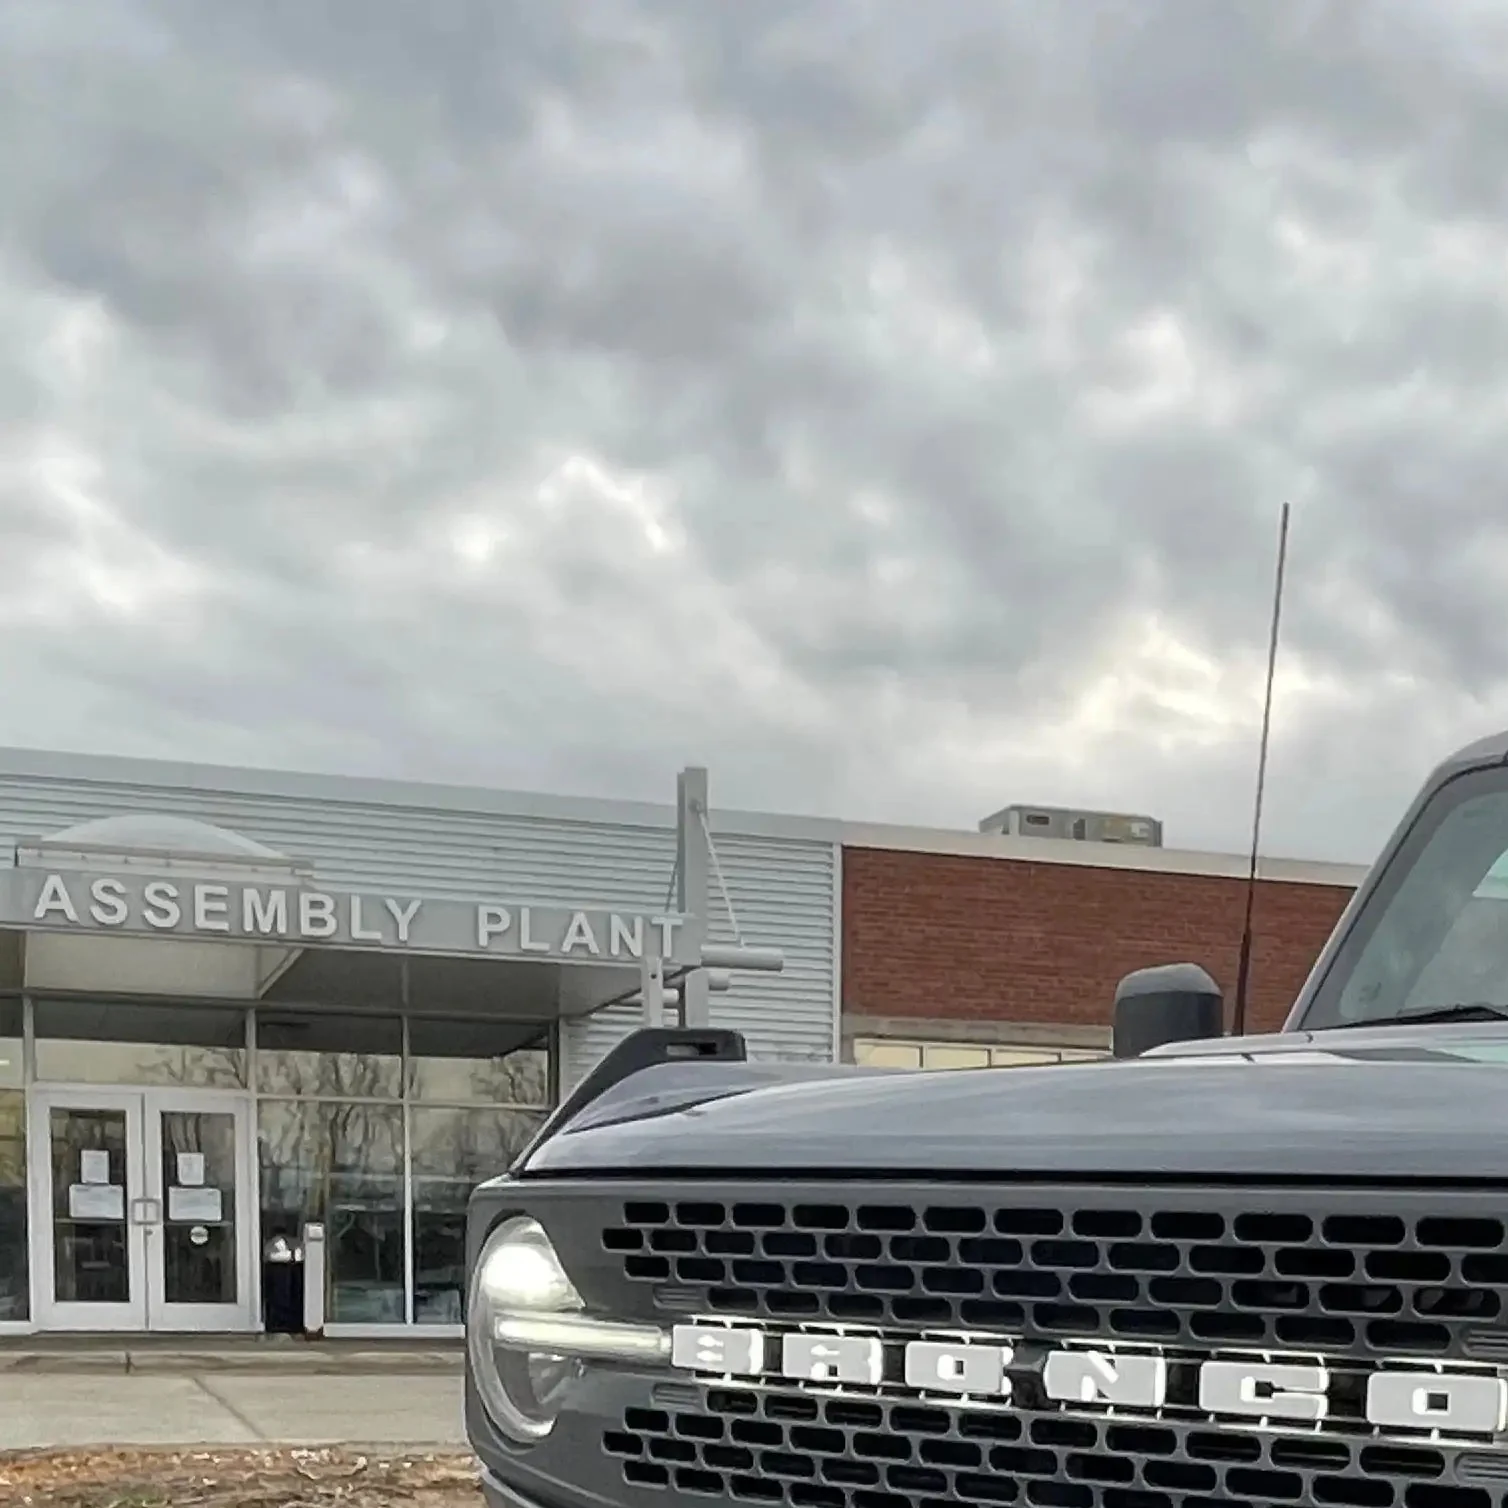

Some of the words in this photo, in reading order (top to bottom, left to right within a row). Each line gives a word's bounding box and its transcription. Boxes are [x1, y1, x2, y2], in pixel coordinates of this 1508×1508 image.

[33, 873, 422, 943] ASSEMBLY
[476, 903, 684, 958] PLANT
[671, 1323, 1508, 1433] BRONCO
